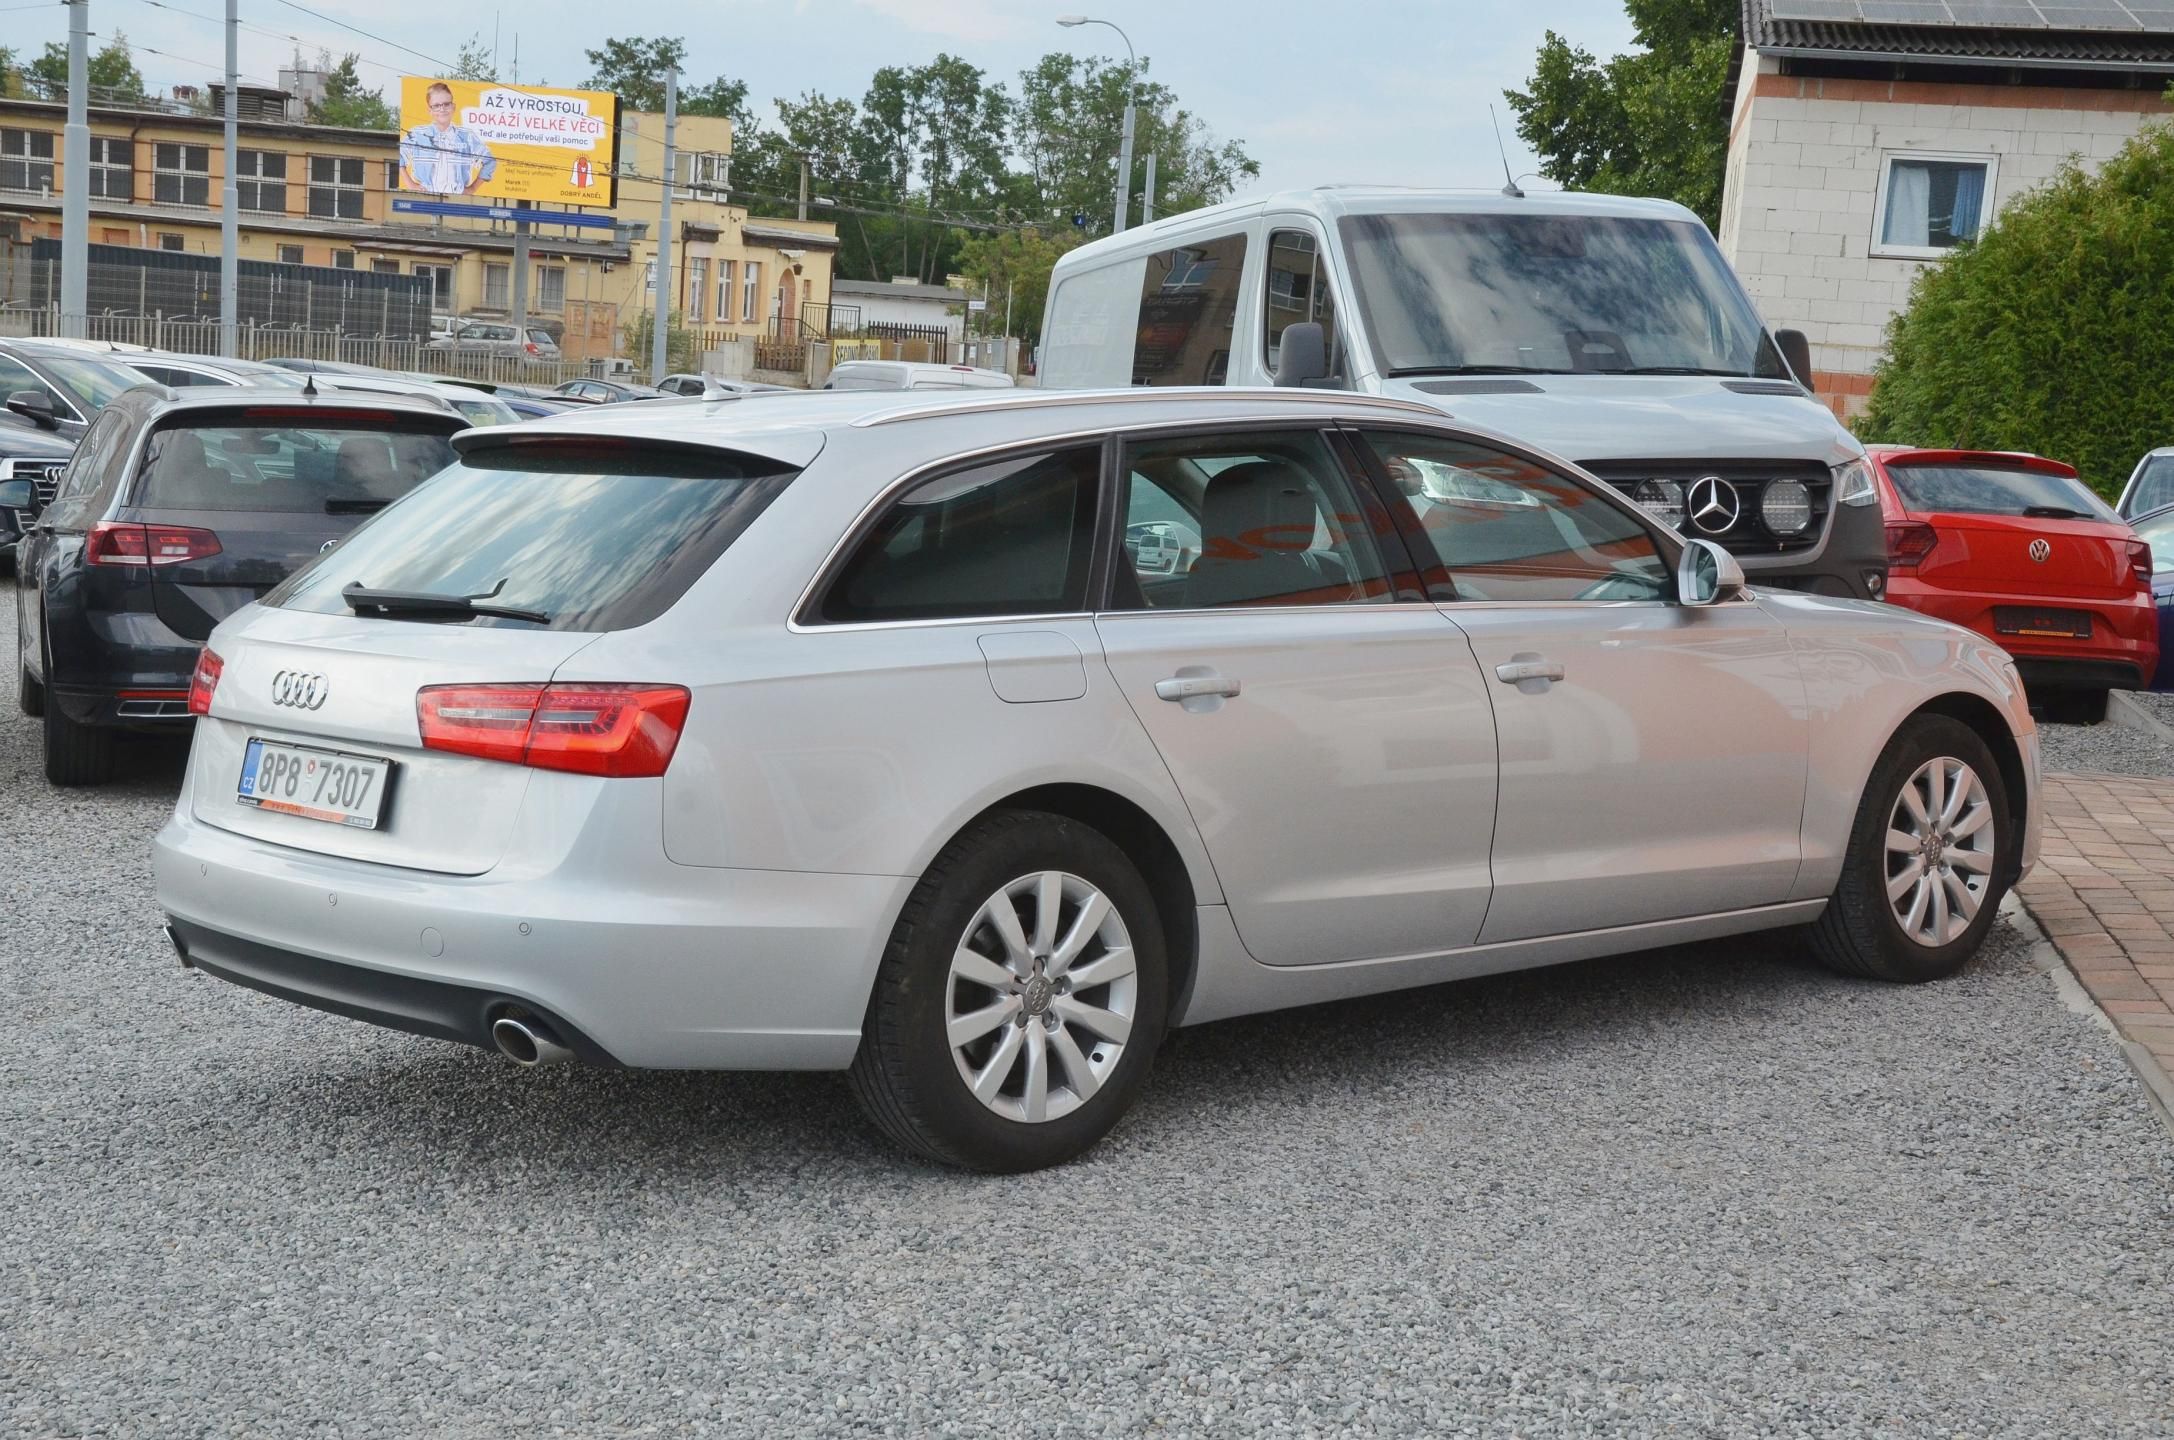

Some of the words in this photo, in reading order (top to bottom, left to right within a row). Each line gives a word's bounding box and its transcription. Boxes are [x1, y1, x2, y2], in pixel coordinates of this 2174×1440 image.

[487, 94, 504, 108] AŽ
[508, 96, 584, 116] VYROSTOU,
[469, 111, 519, 127] DOKÁŽÍ
[525, 116, 565, 131] VELKÉ
[571, 119, 600, 134] VĚCI
[480, 129, 493, 138] Teď
[509, 133, 543, 143] potřebují
[243, 777, 254, 789] CZ
[259, 752, 301, 797] 8P8
[313, 759, 376, 810] 7307
